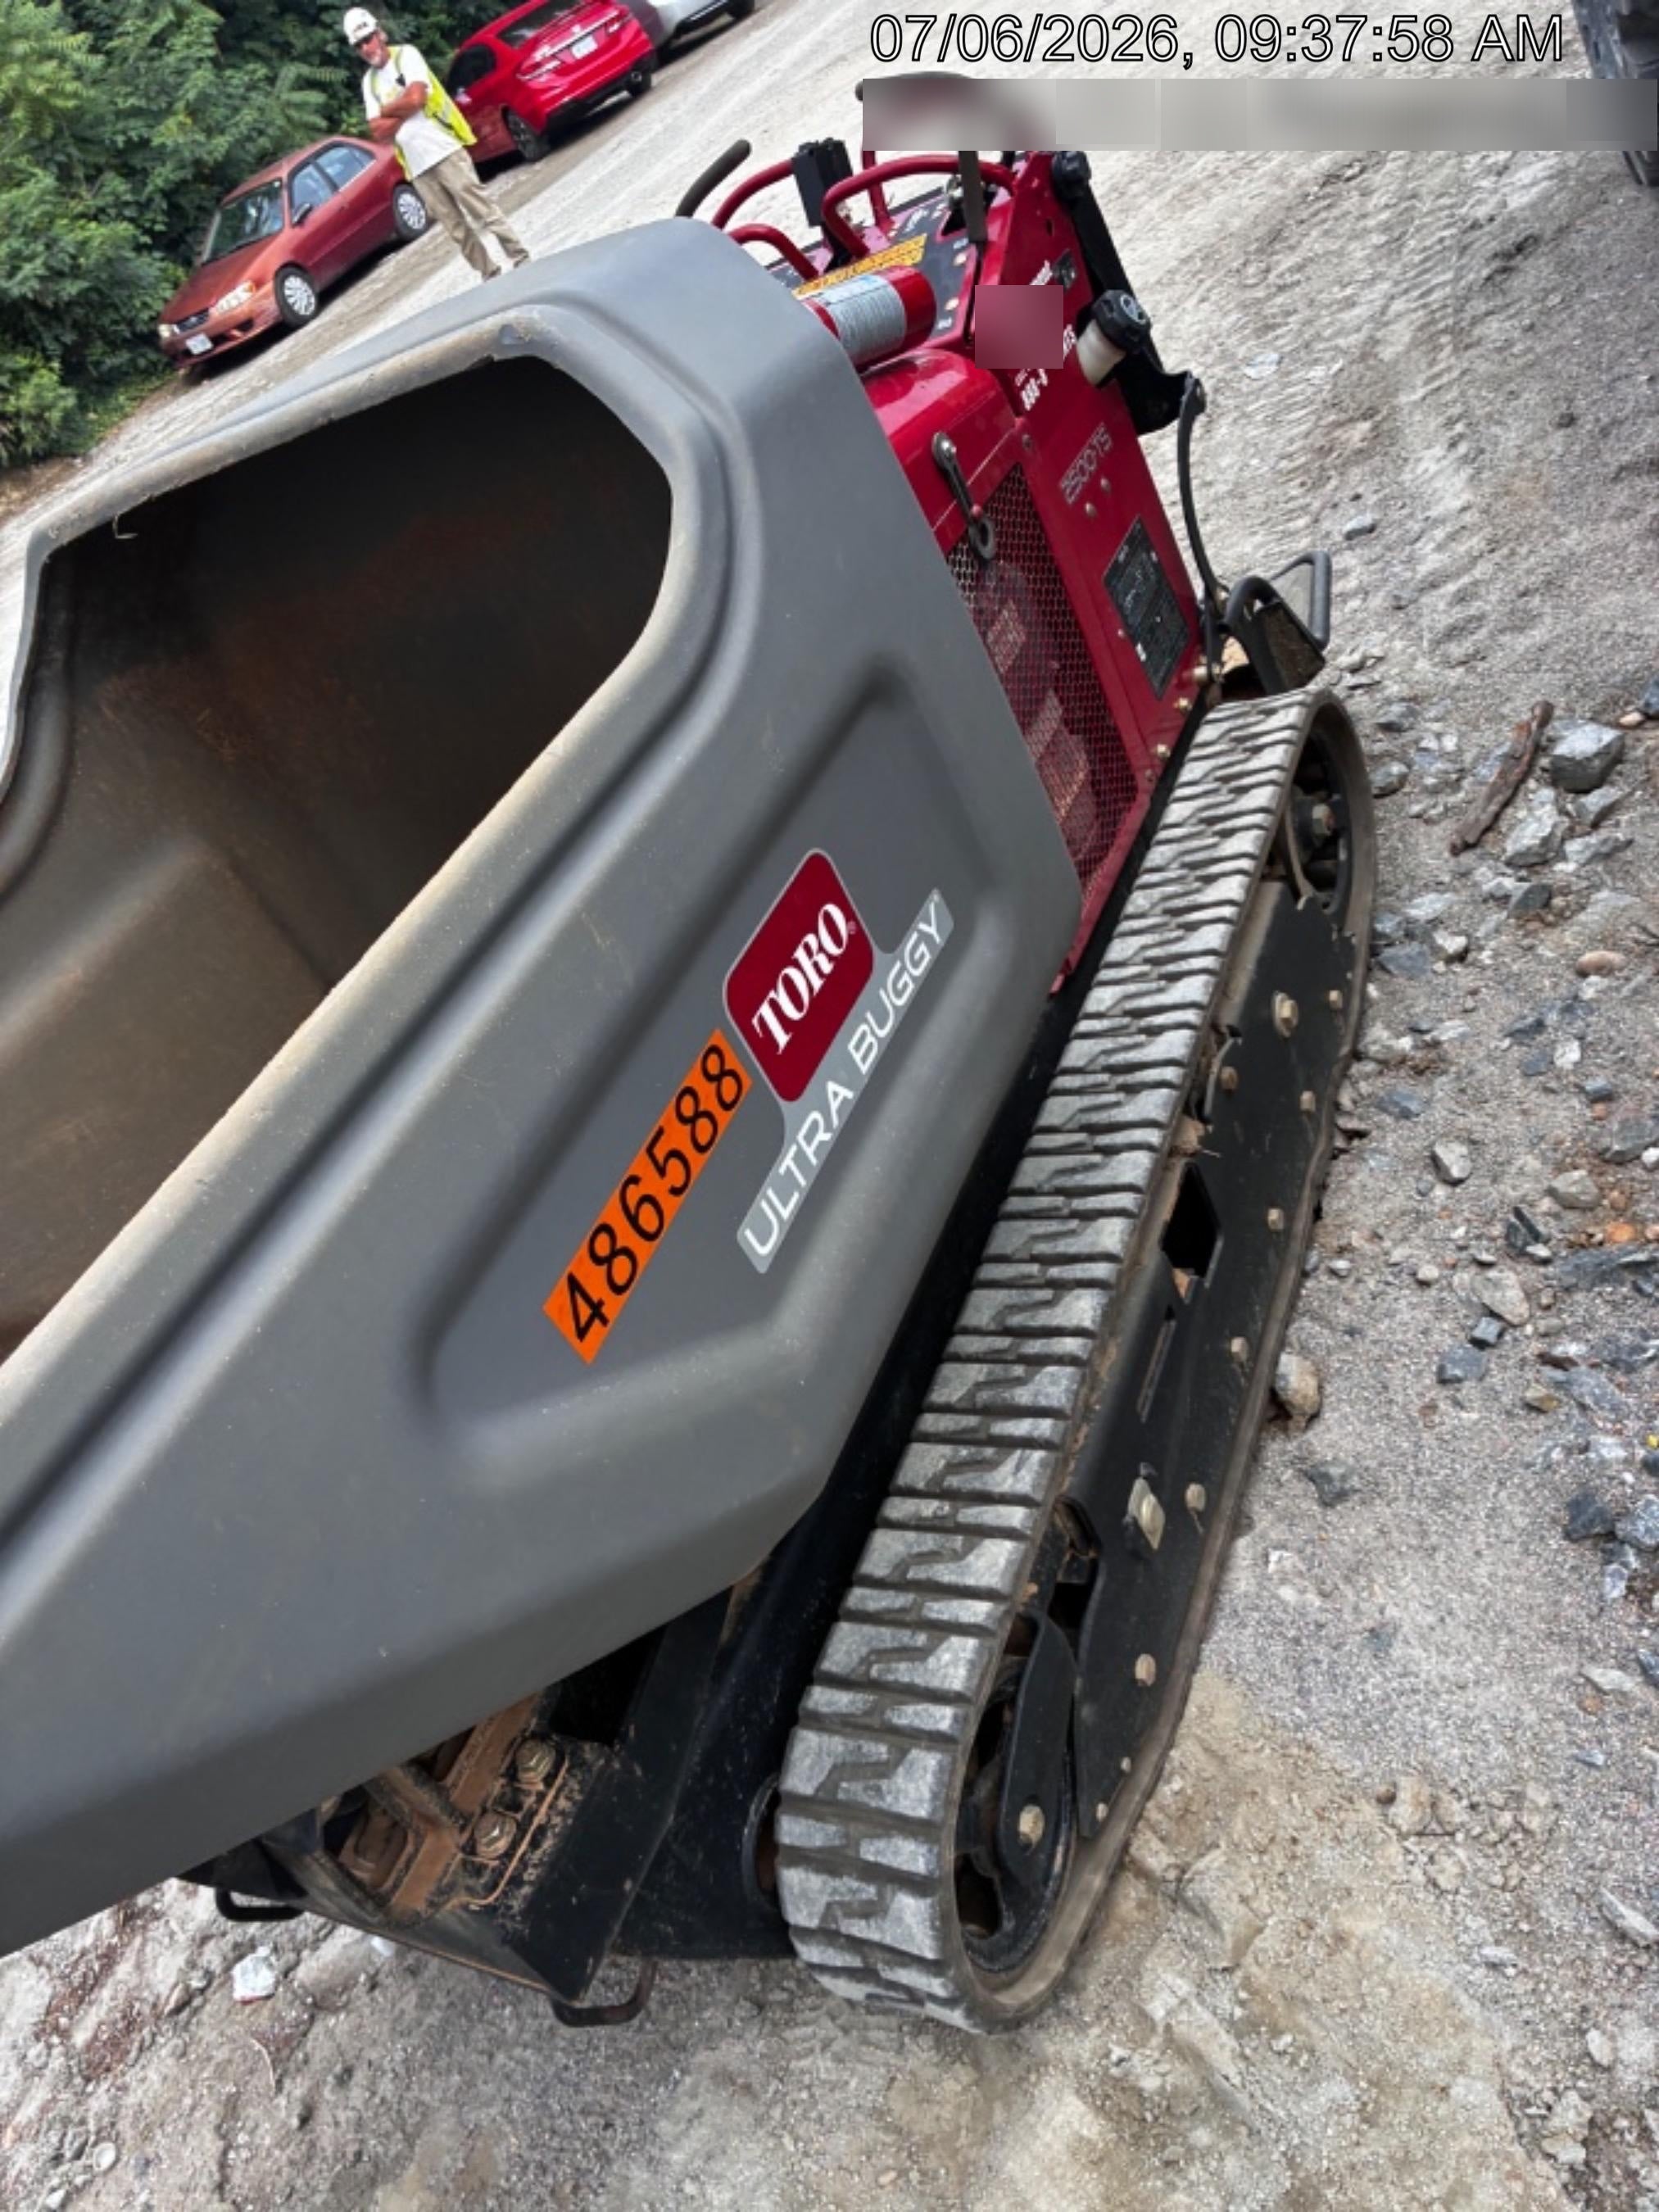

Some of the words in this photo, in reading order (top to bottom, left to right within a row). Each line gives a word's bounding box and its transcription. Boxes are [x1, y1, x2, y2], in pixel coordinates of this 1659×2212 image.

[744, 1079, 854, 1255] ULTRA
[848, 901, 941, 1074] BUGGY
[751, 903, 849, 1055] TORO
[566, 1044, 743, 1344] 486588
